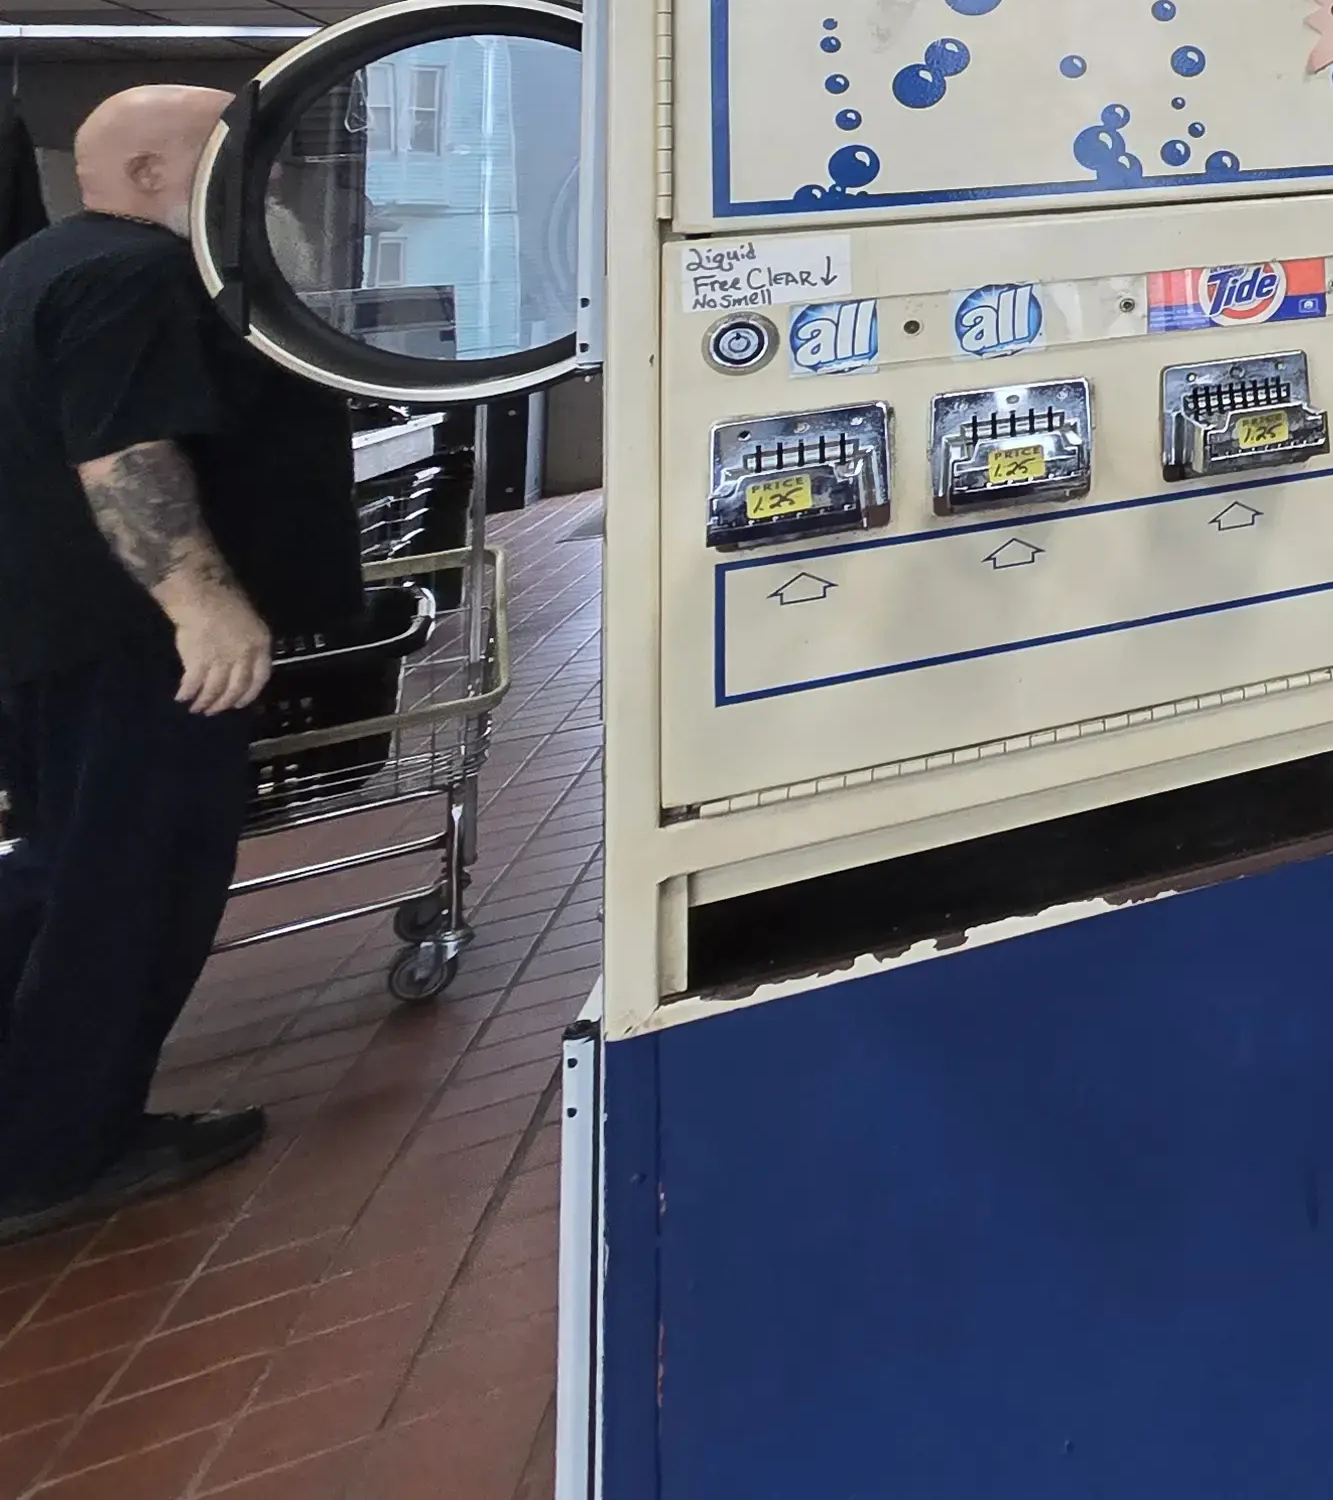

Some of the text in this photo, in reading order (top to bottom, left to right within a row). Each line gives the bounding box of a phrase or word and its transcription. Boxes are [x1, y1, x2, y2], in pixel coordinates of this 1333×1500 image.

[686, 242, 757, 272] Liquid
[693, 275, 742, 296] Free
[1207, 266, 1278, 316] Tide
[794, 301, 877, 367] all
[960, 285, 1036, 354] all
[993, 445, 1041, 461] PRICE
[751, 476, 804, 494] PRICE
